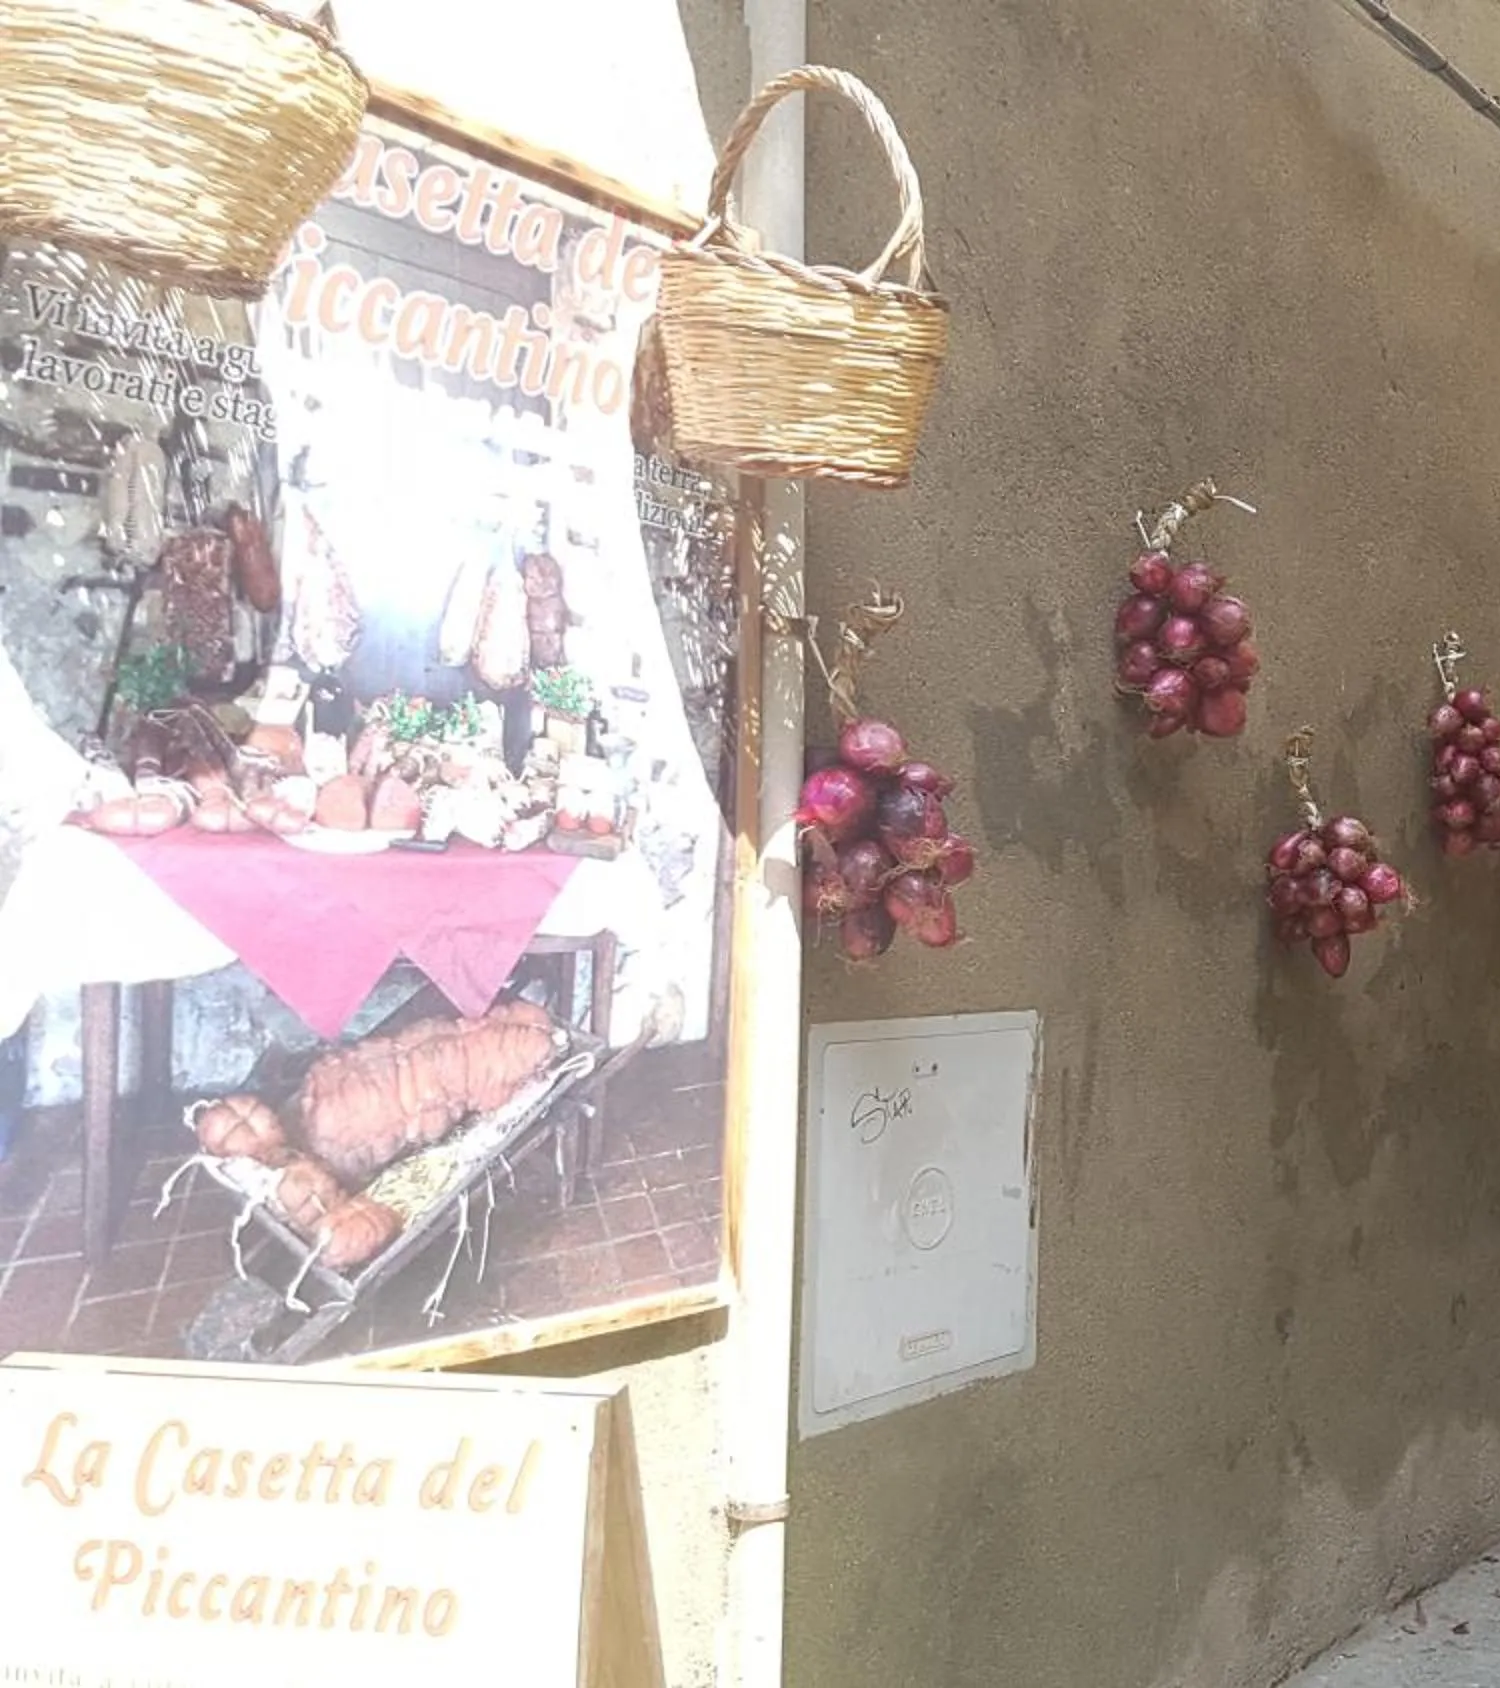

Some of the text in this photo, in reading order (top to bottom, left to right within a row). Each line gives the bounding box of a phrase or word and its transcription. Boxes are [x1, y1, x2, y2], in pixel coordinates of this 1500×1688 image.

[335, 132, 660, 304] asetta de
[26, 281, 69, 329] Vi
[197, 336, 216, 365] a
[282, 223, 624, 416] iccantino
[23, 339, 278, 441] lavorati e stag
[22, 1410, 542, 1518] La Casetta del
[73, 1539, 461, 1638] Piccantino
